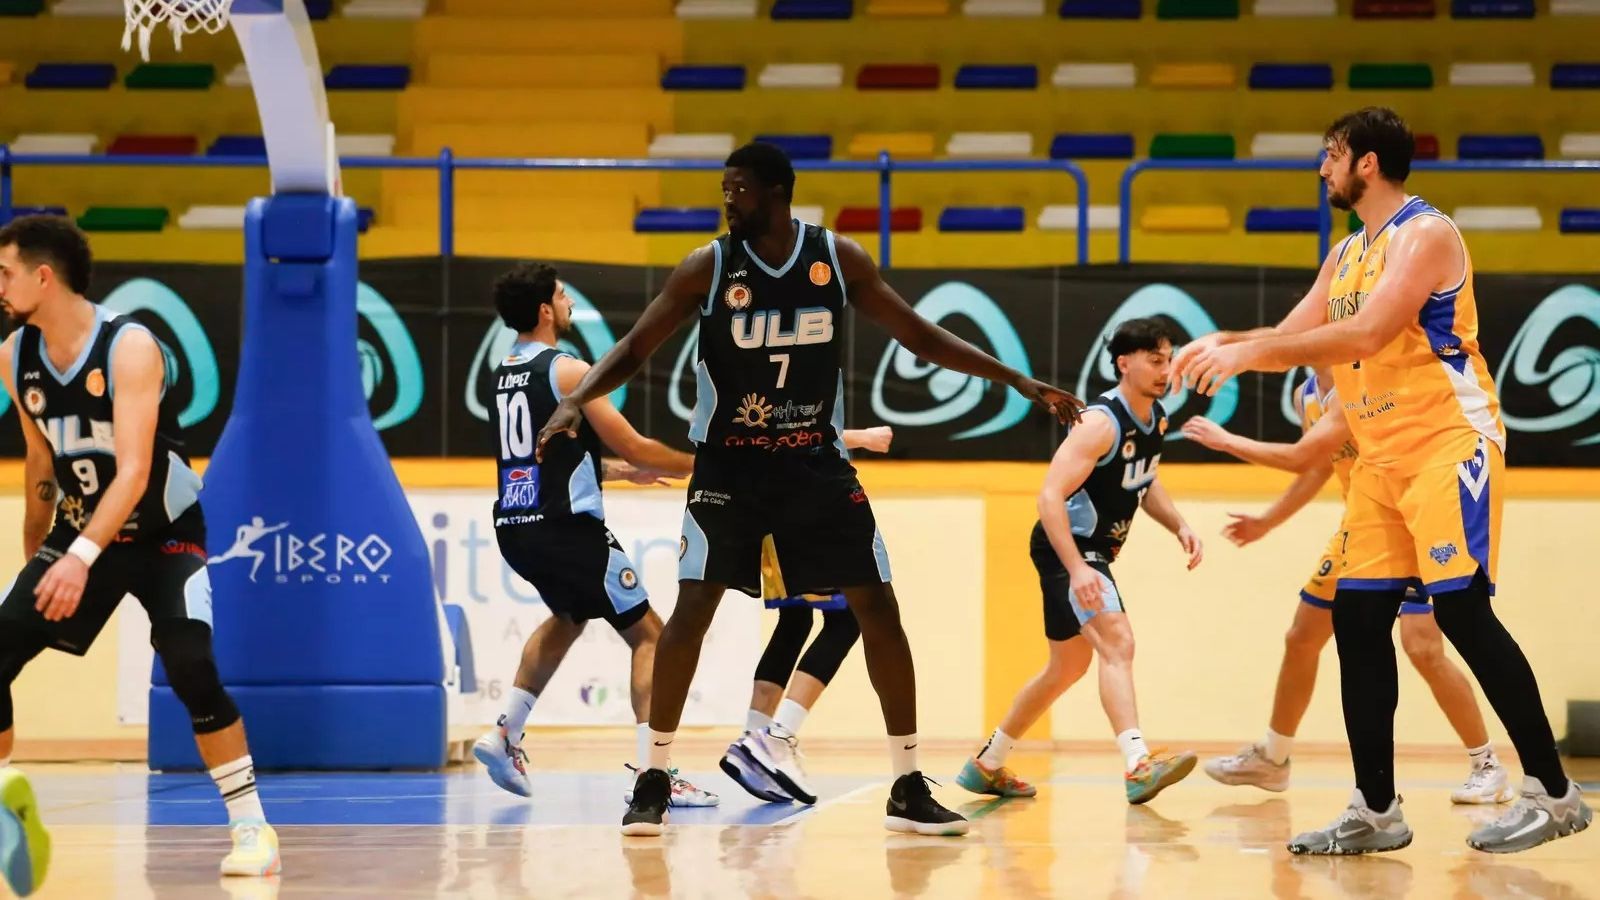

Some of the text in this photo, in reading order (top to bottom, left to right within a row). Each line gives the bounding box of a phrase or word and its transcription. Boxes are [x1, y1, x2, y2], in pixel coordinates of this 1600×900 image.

[728, 270, 748, 279] vive
[731, 305, 834, 349] ULB
[769, 353, 790, 389] 7
[496, 391, 533, 460] 10
[72, 459, 99, 495] 9
[275, 533, 392, 572] IBERO
[275, 574, 391, 584] SPORT
